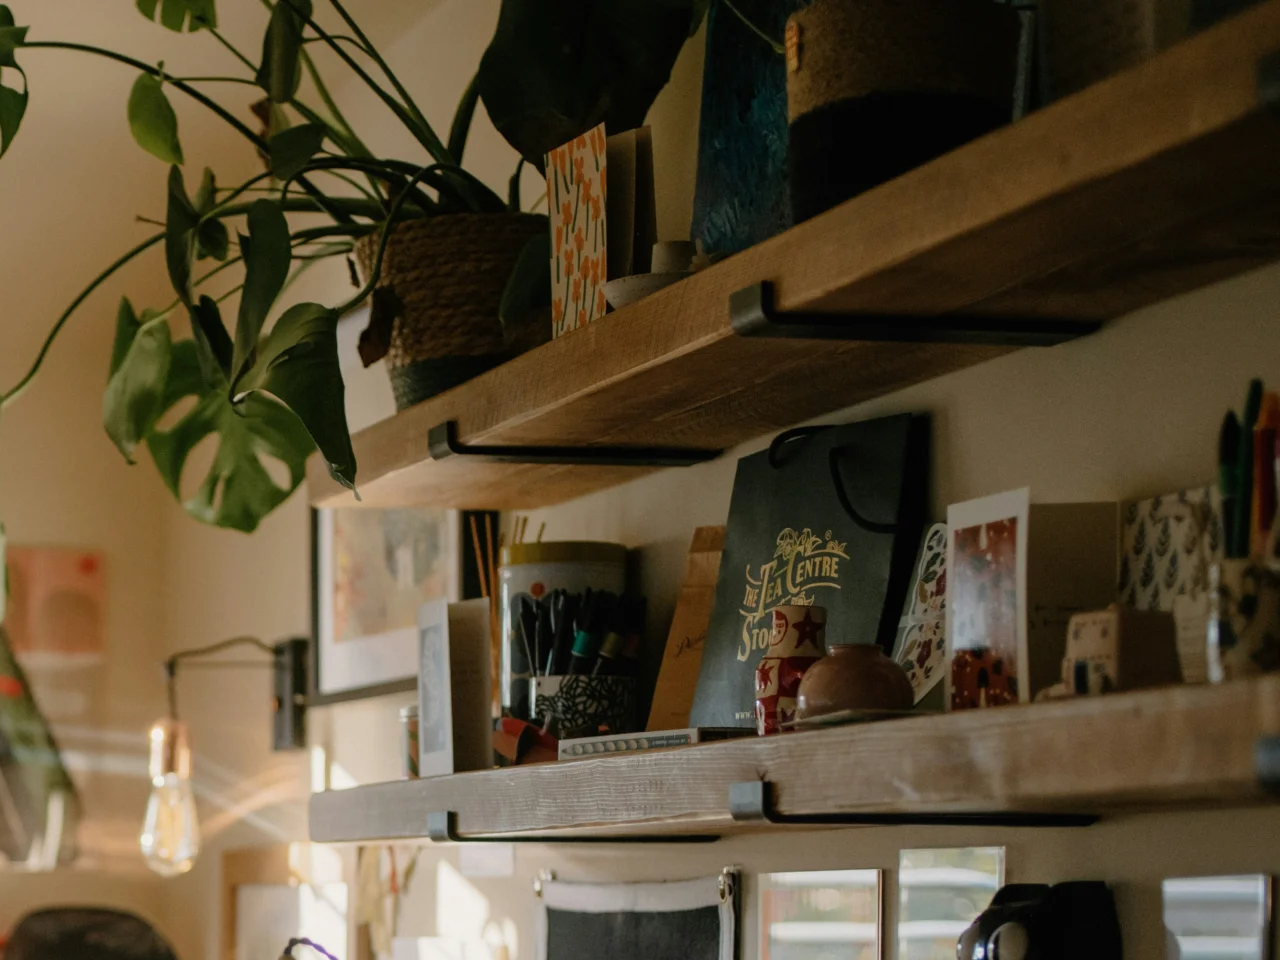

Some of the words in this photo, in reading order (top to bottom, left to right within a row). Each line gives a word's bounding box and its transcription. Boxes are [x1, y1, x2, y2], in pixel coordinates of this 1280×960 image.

[743, 584, 759, 607] THE
[754, 560, 782, 621] TEA
[786, 545, 840, 594] CENTRE
[737, 615, 774, 662] STO
